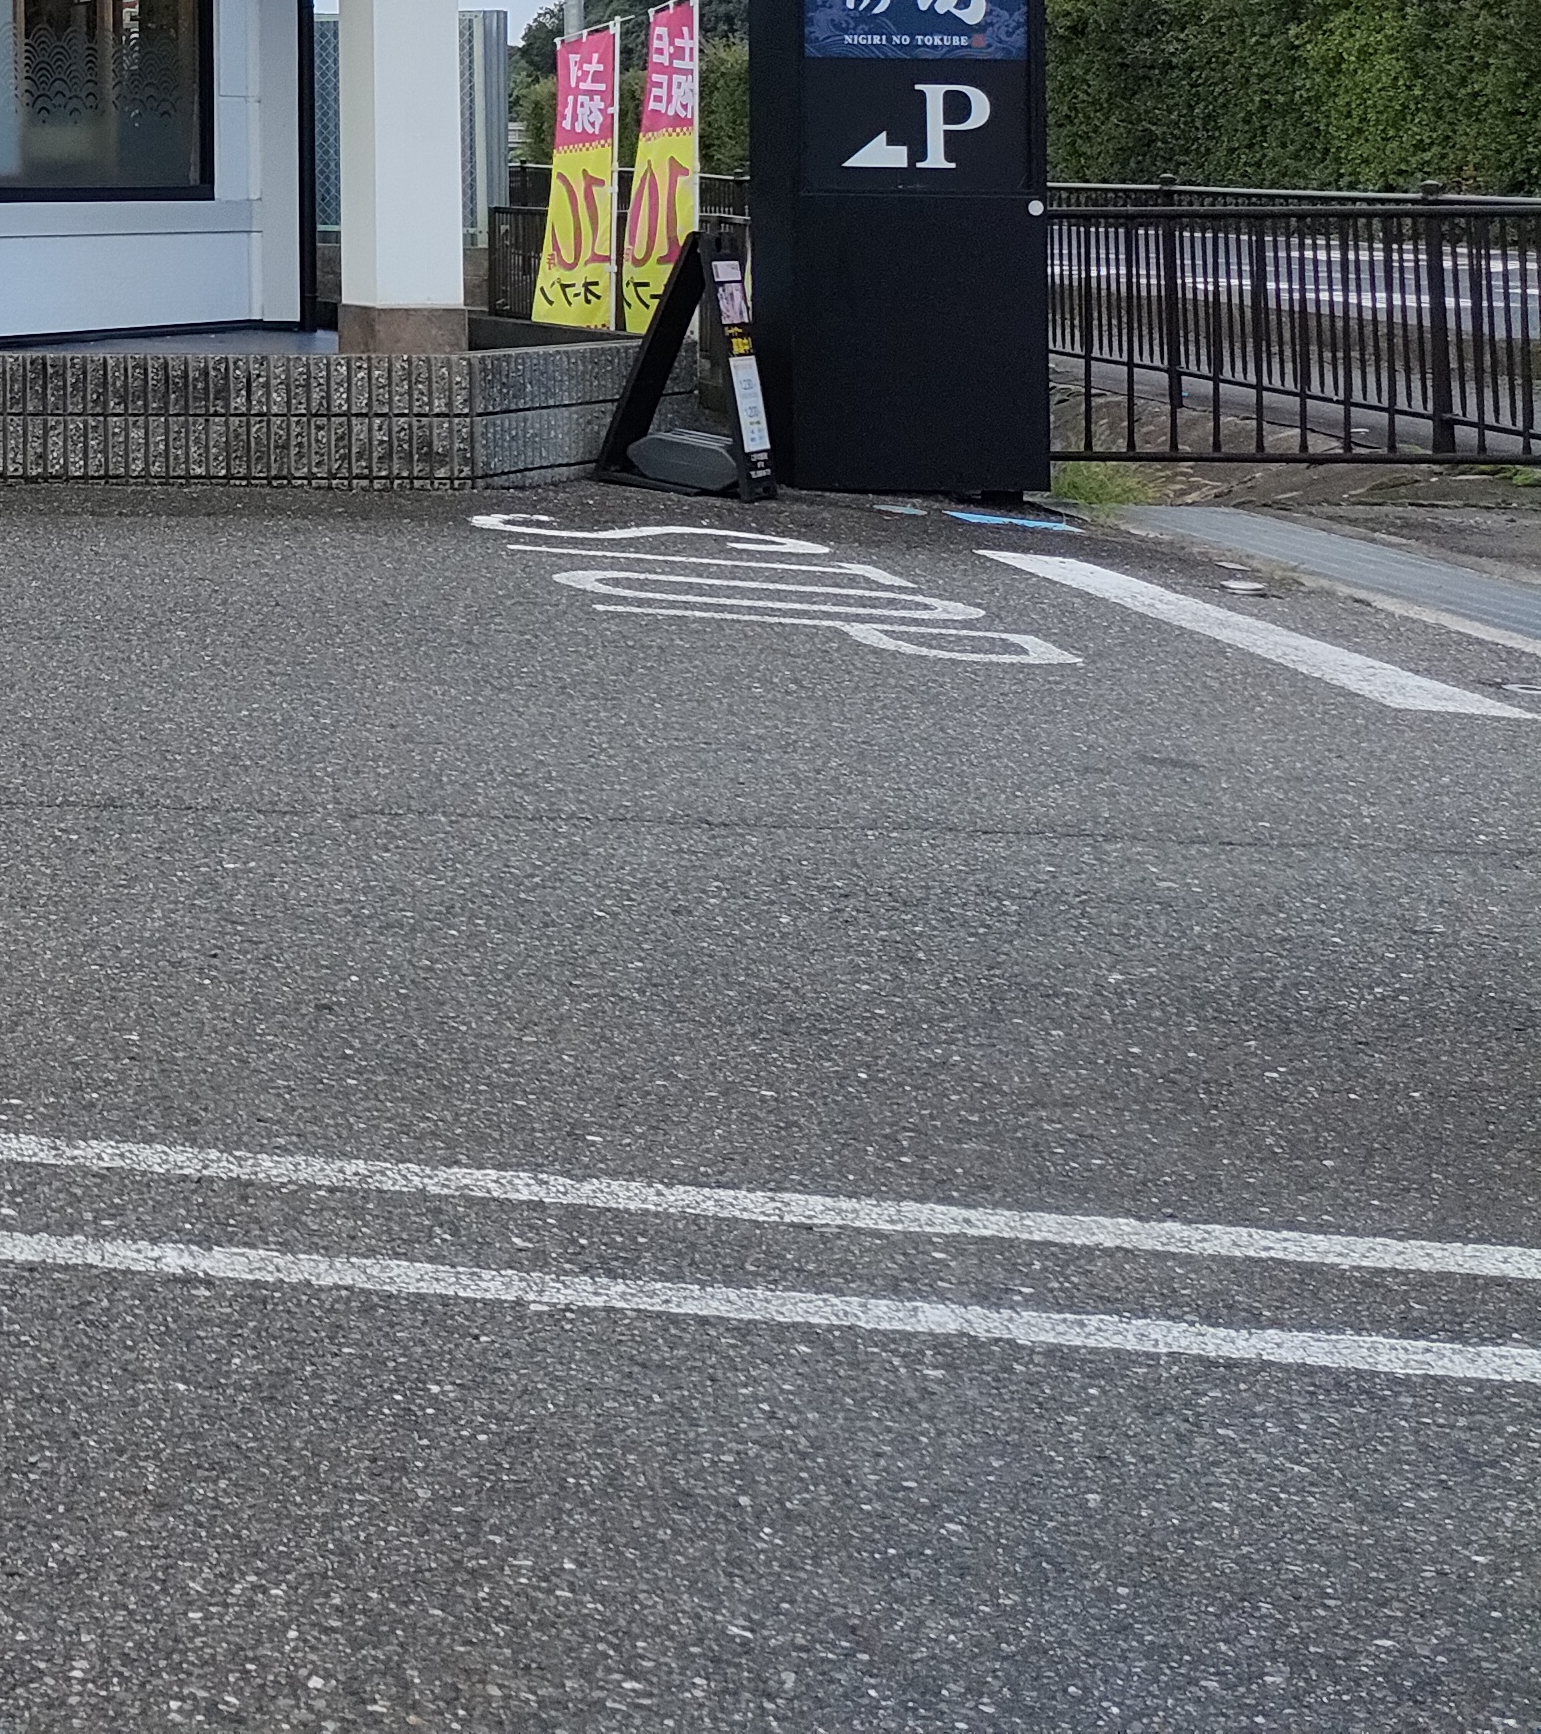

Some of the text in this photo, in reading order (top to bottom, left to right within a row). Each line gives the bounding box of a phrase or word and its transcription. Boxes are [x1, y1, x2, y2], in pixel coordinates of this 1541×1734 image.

[844, 34, 968, 46] NIGIRI NO TOKUBE
[914, 84, 992, 169] P
